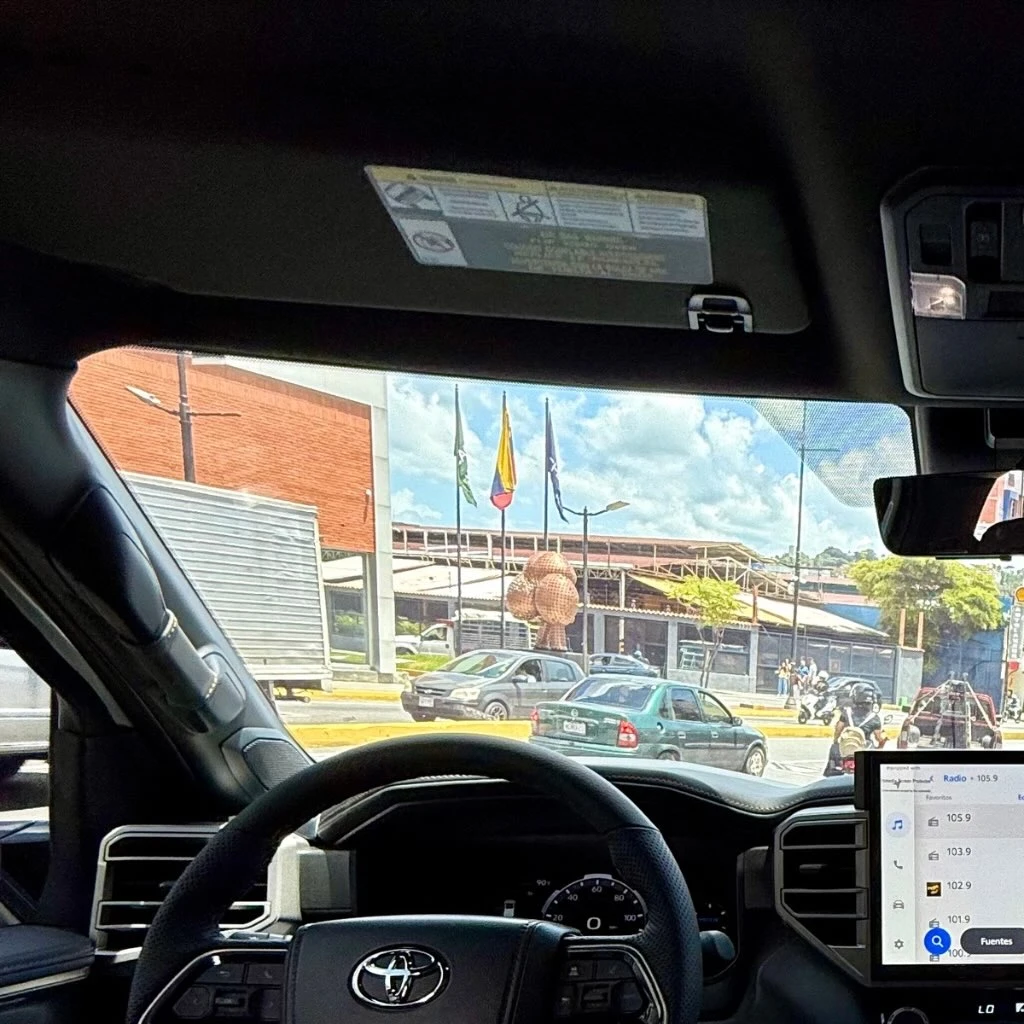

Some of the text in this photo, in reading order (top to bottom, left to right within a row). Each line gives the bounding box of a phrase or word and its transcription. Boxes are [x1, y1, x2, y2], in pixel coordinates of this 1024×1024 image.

[943, 774, 998, 782] Radio 105.9
[947, 813, 972, 822] 105.9
[947, 847, 972, 856] 103.9
[591, 885, 603, 894] 60
[947, 881, 972, 890] 102.9
[567, 893, 579, 902] 40
[614, 893, 625, 902] 80
[552, 914, 564, 922] 20
[623, 914, 637, 922] 100
[948, 915, 971, 924] 101.9
[586, 917, 601, 930] 0
[980, 937, 1013, 946] Fuentes
[977, 1004, 995, 1014] LO
